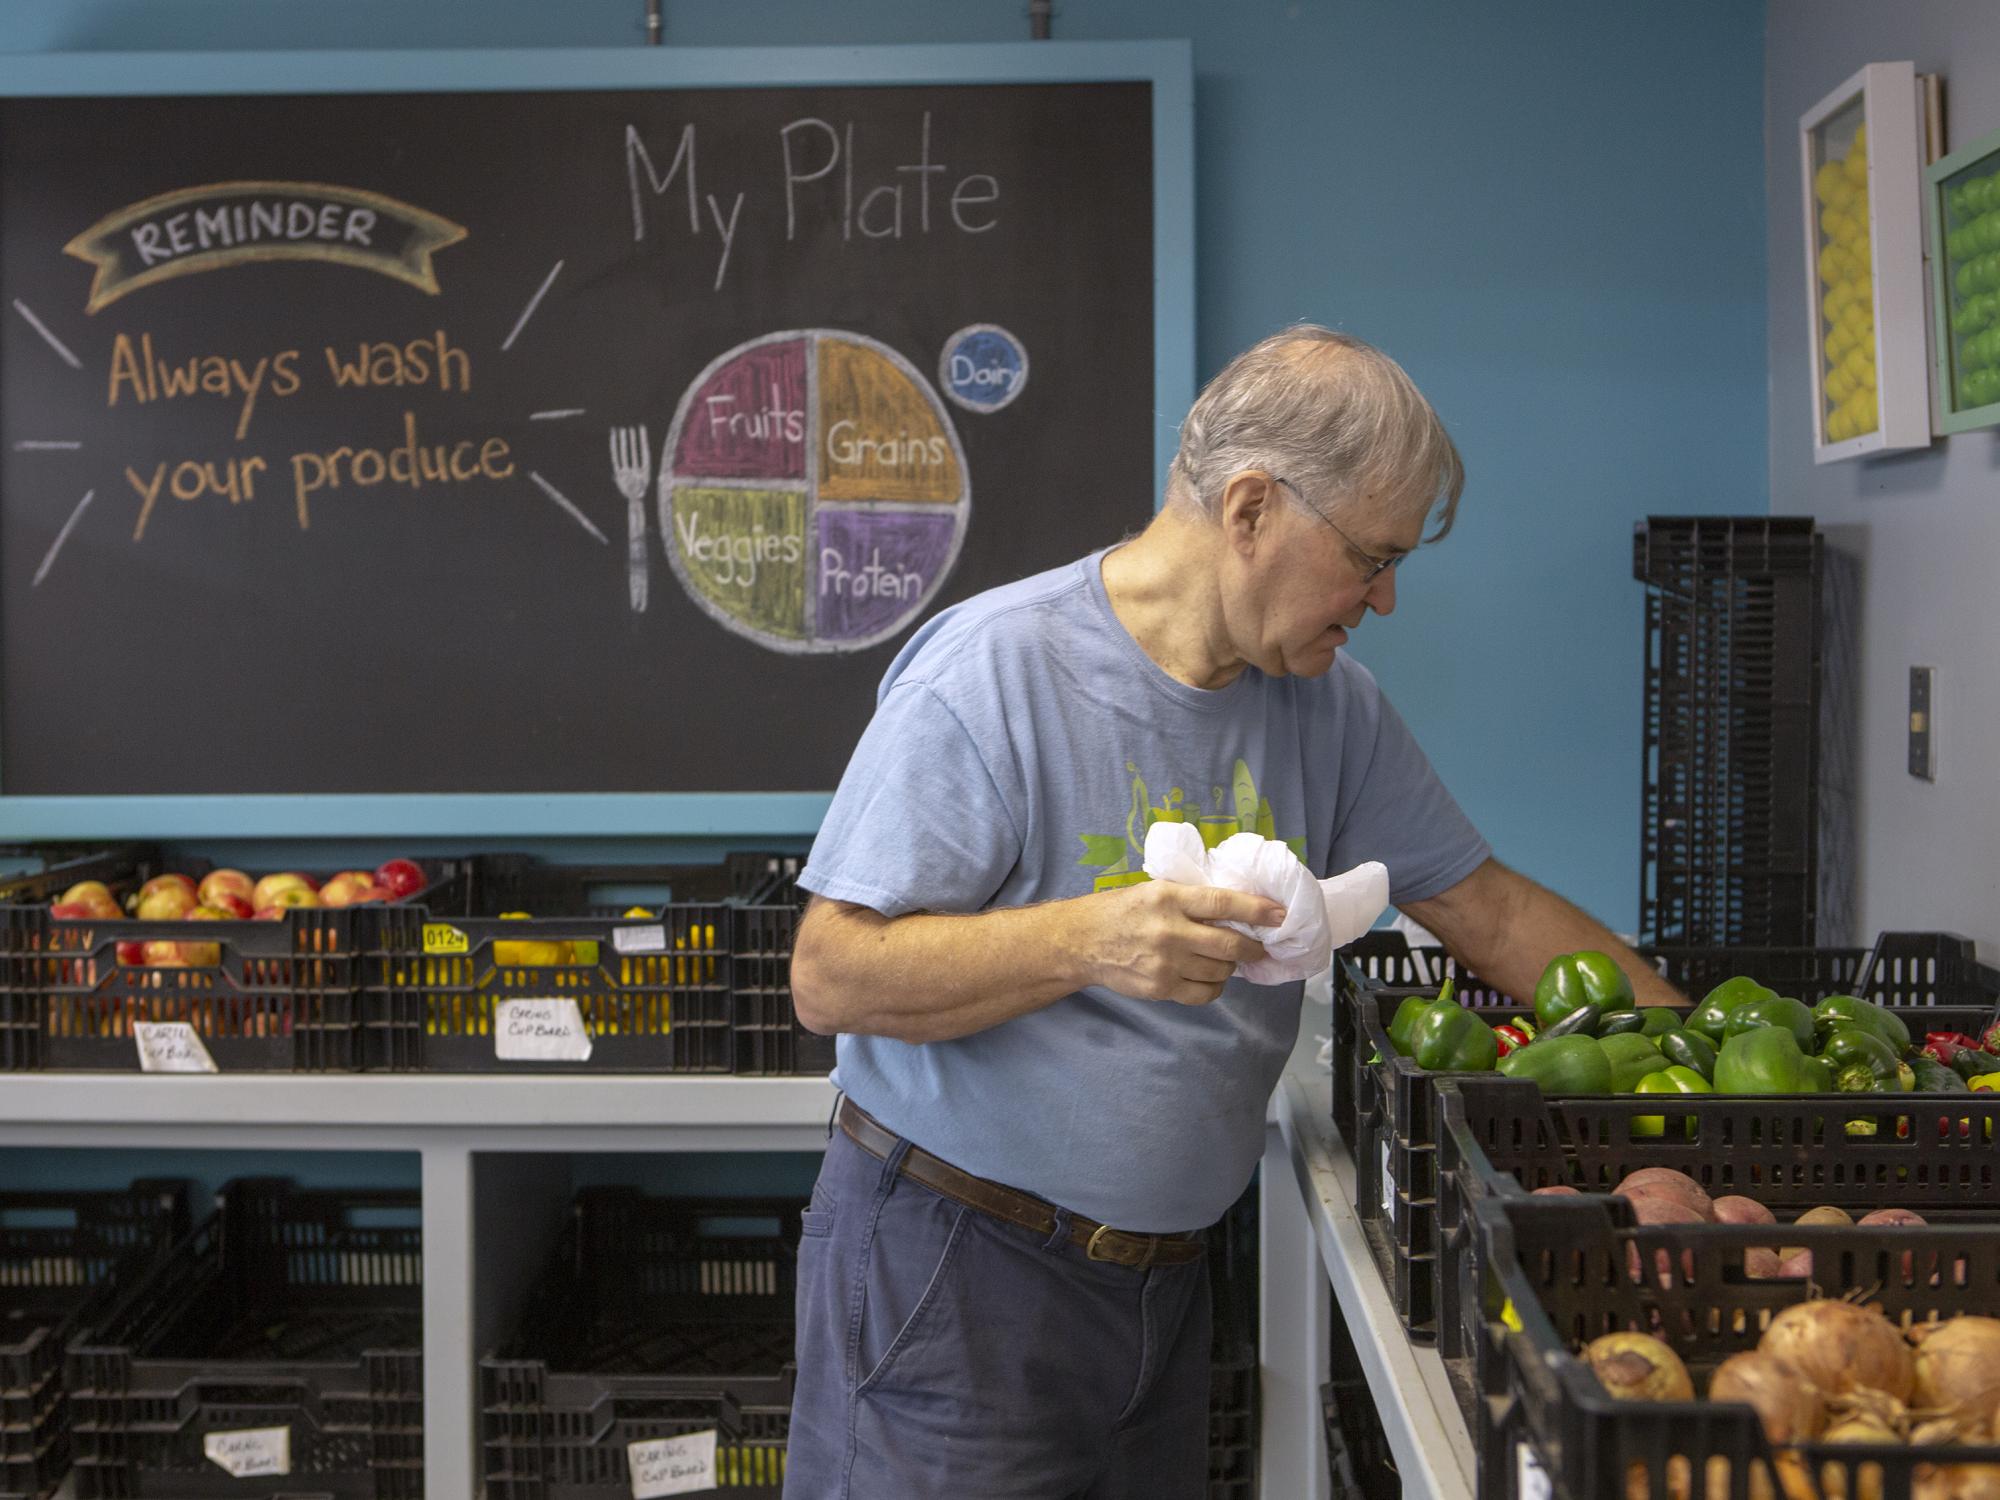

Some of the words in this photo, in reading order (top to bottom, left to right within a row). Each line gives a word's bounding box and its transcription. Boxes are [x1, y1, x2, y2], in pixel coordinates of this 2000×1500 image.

[627, 122, 745, 291] My
[780, 110, 1000, 241] Plate
[131, 201, 377, 267] REMINDER
[107, 332, 301, 441] Always
[325, 329, 472, 393] wash
[951, 354, 1022, 393] Dairy
[706, 382, 805, 443] Fruits
[827, 419, 946, 467] Grains
[125, 455, 268, 543] your
[291, 410, 515, 530] produce
[675, 510, 801, 588] Veggies
[818, 546, 924, 600] Protein
